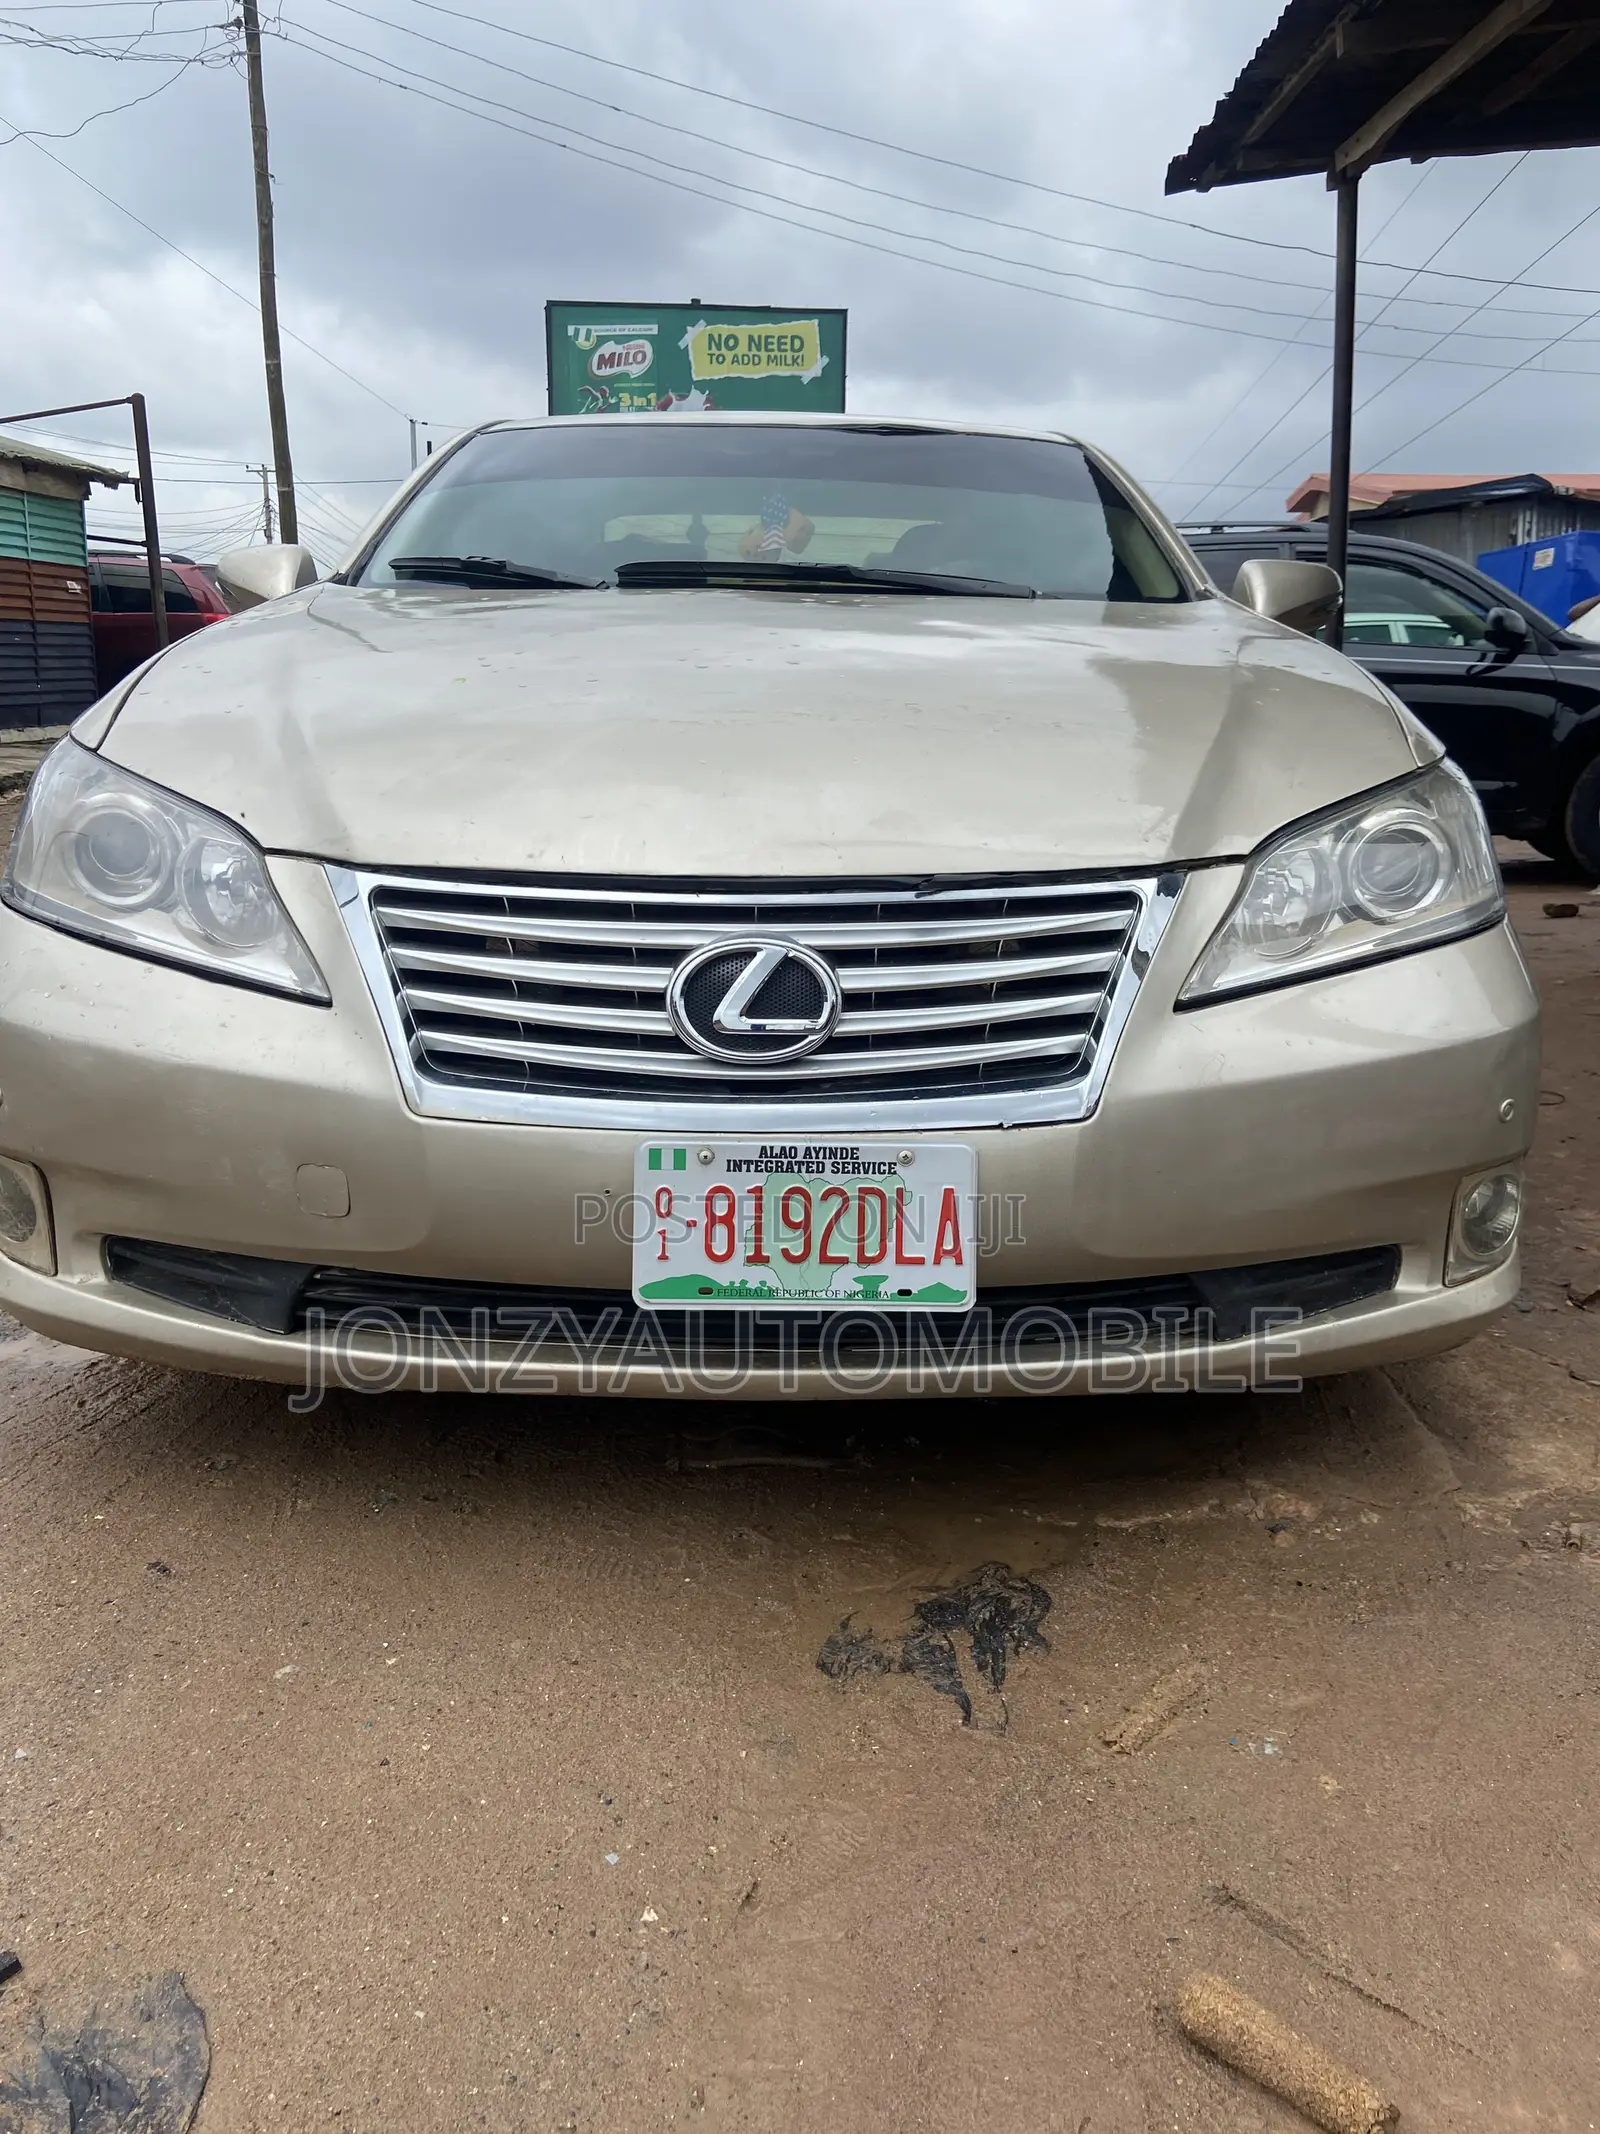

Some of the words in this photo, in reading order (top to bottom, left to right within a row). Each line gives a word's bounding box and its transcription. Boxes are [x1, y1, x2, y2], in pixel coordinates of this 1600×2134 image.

[707, 333, 740, 352] NO
[747, 334, 805, 353] NEED
[596, 349, 647, 371] MILO
[707, 353, 726, 365] TO
[731, 354, 762, 366] ADD
[766, 354, 805, 367] MILK!
[758, 1145, 798, 1160] ALAO
[802, 1146, 860, 1161] AYINDE
[726, 1159, 826, 1174] INTEGRATED
[830, 1161, 898, 1175] SERVICE
[716, 1288, 766, 1298] FEDERAL
[768, 1288, 824, 1299] REPUBLIC
[825, 1289, 841, 1298] OF
[844, 1290, 890, 1299] NIGERIA
